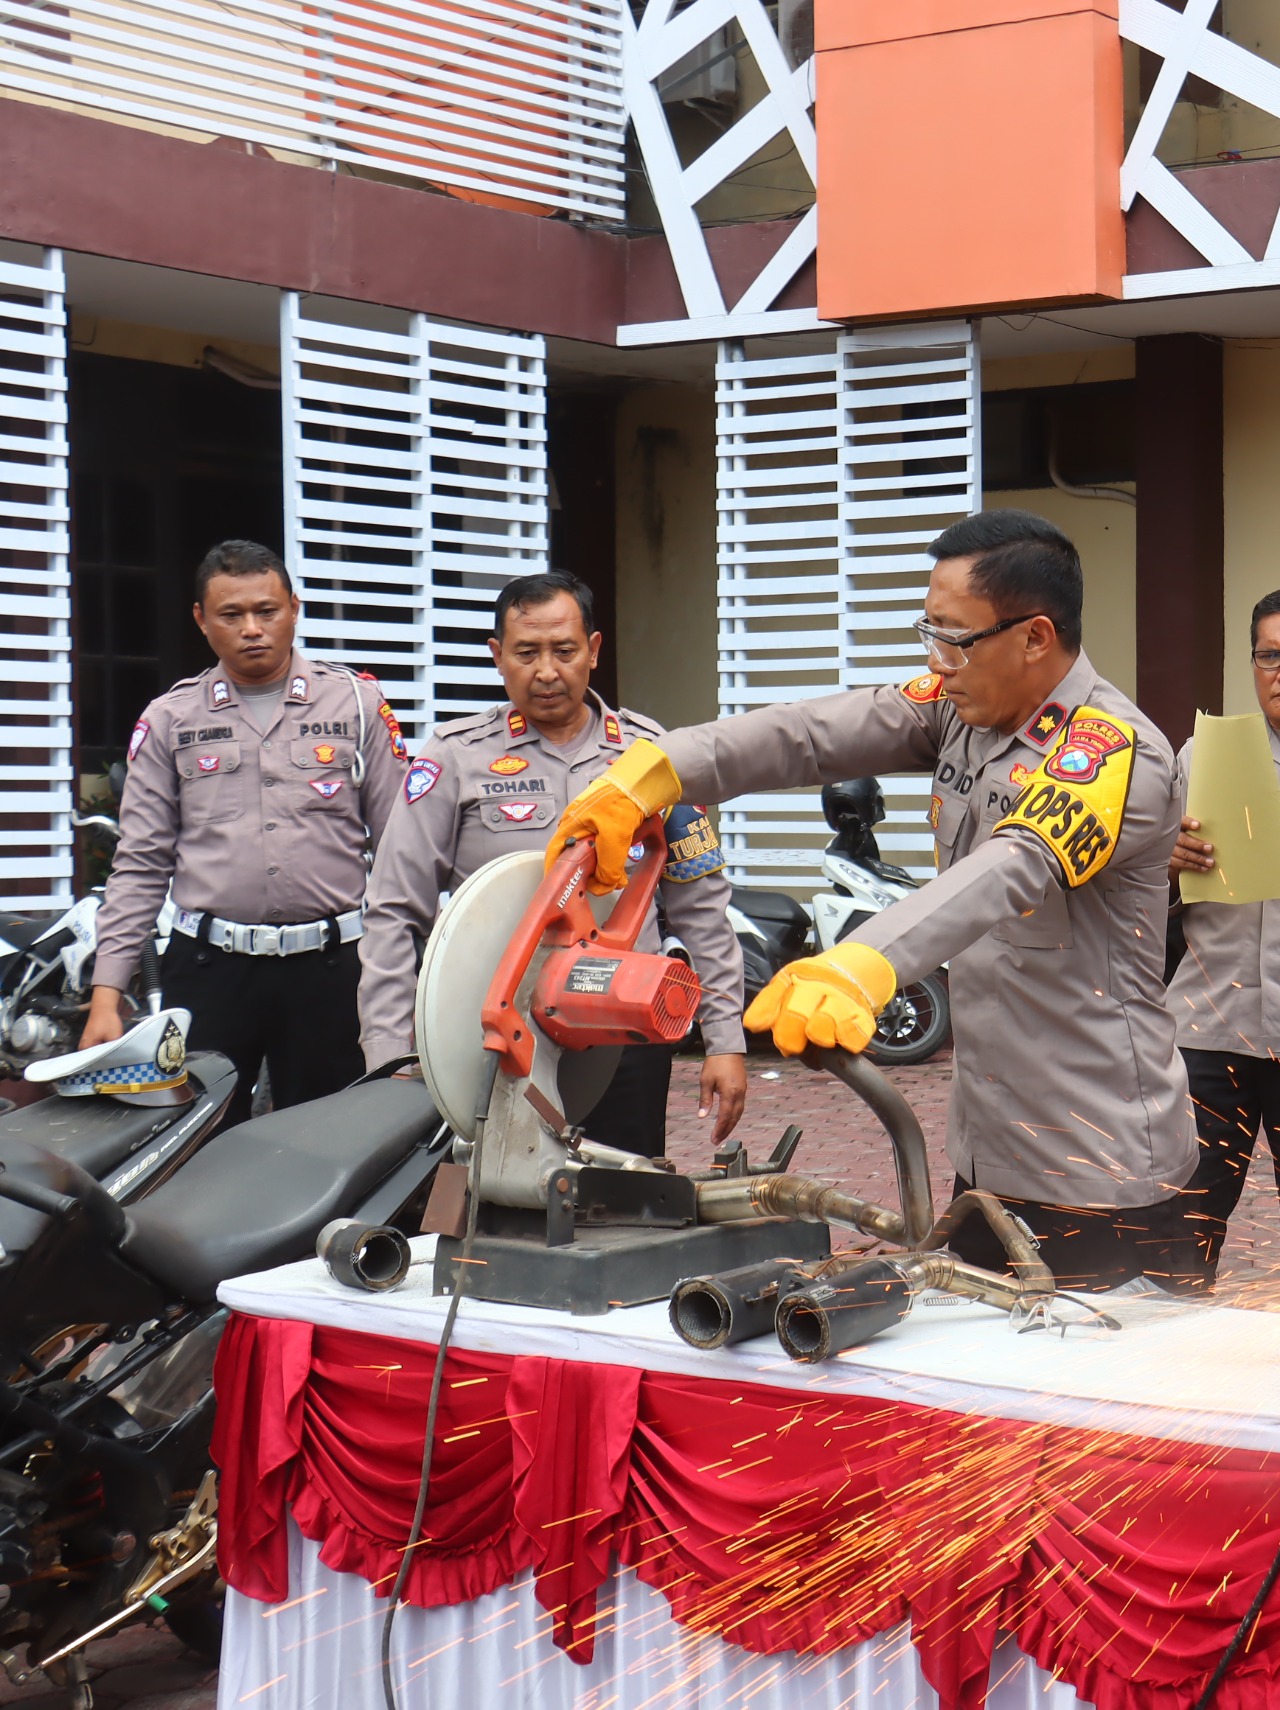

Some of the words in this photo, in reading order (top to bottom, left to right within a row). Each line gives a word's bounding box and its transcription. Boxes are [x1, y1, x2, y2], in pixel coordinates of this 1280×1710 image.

[300, 721, 349, 737] POLRI
[1074, 722, 1121, 743] POLRES
[481, 779, 546, 795] TOHARI
[1024, 784, 1083, 839] OPS
[1063, 813, 1111, 876] RES
[669, 825, 718, 861] TURJA
[557, 866, 585, 909] maktec
[572, 983, 604, 992] maktec
